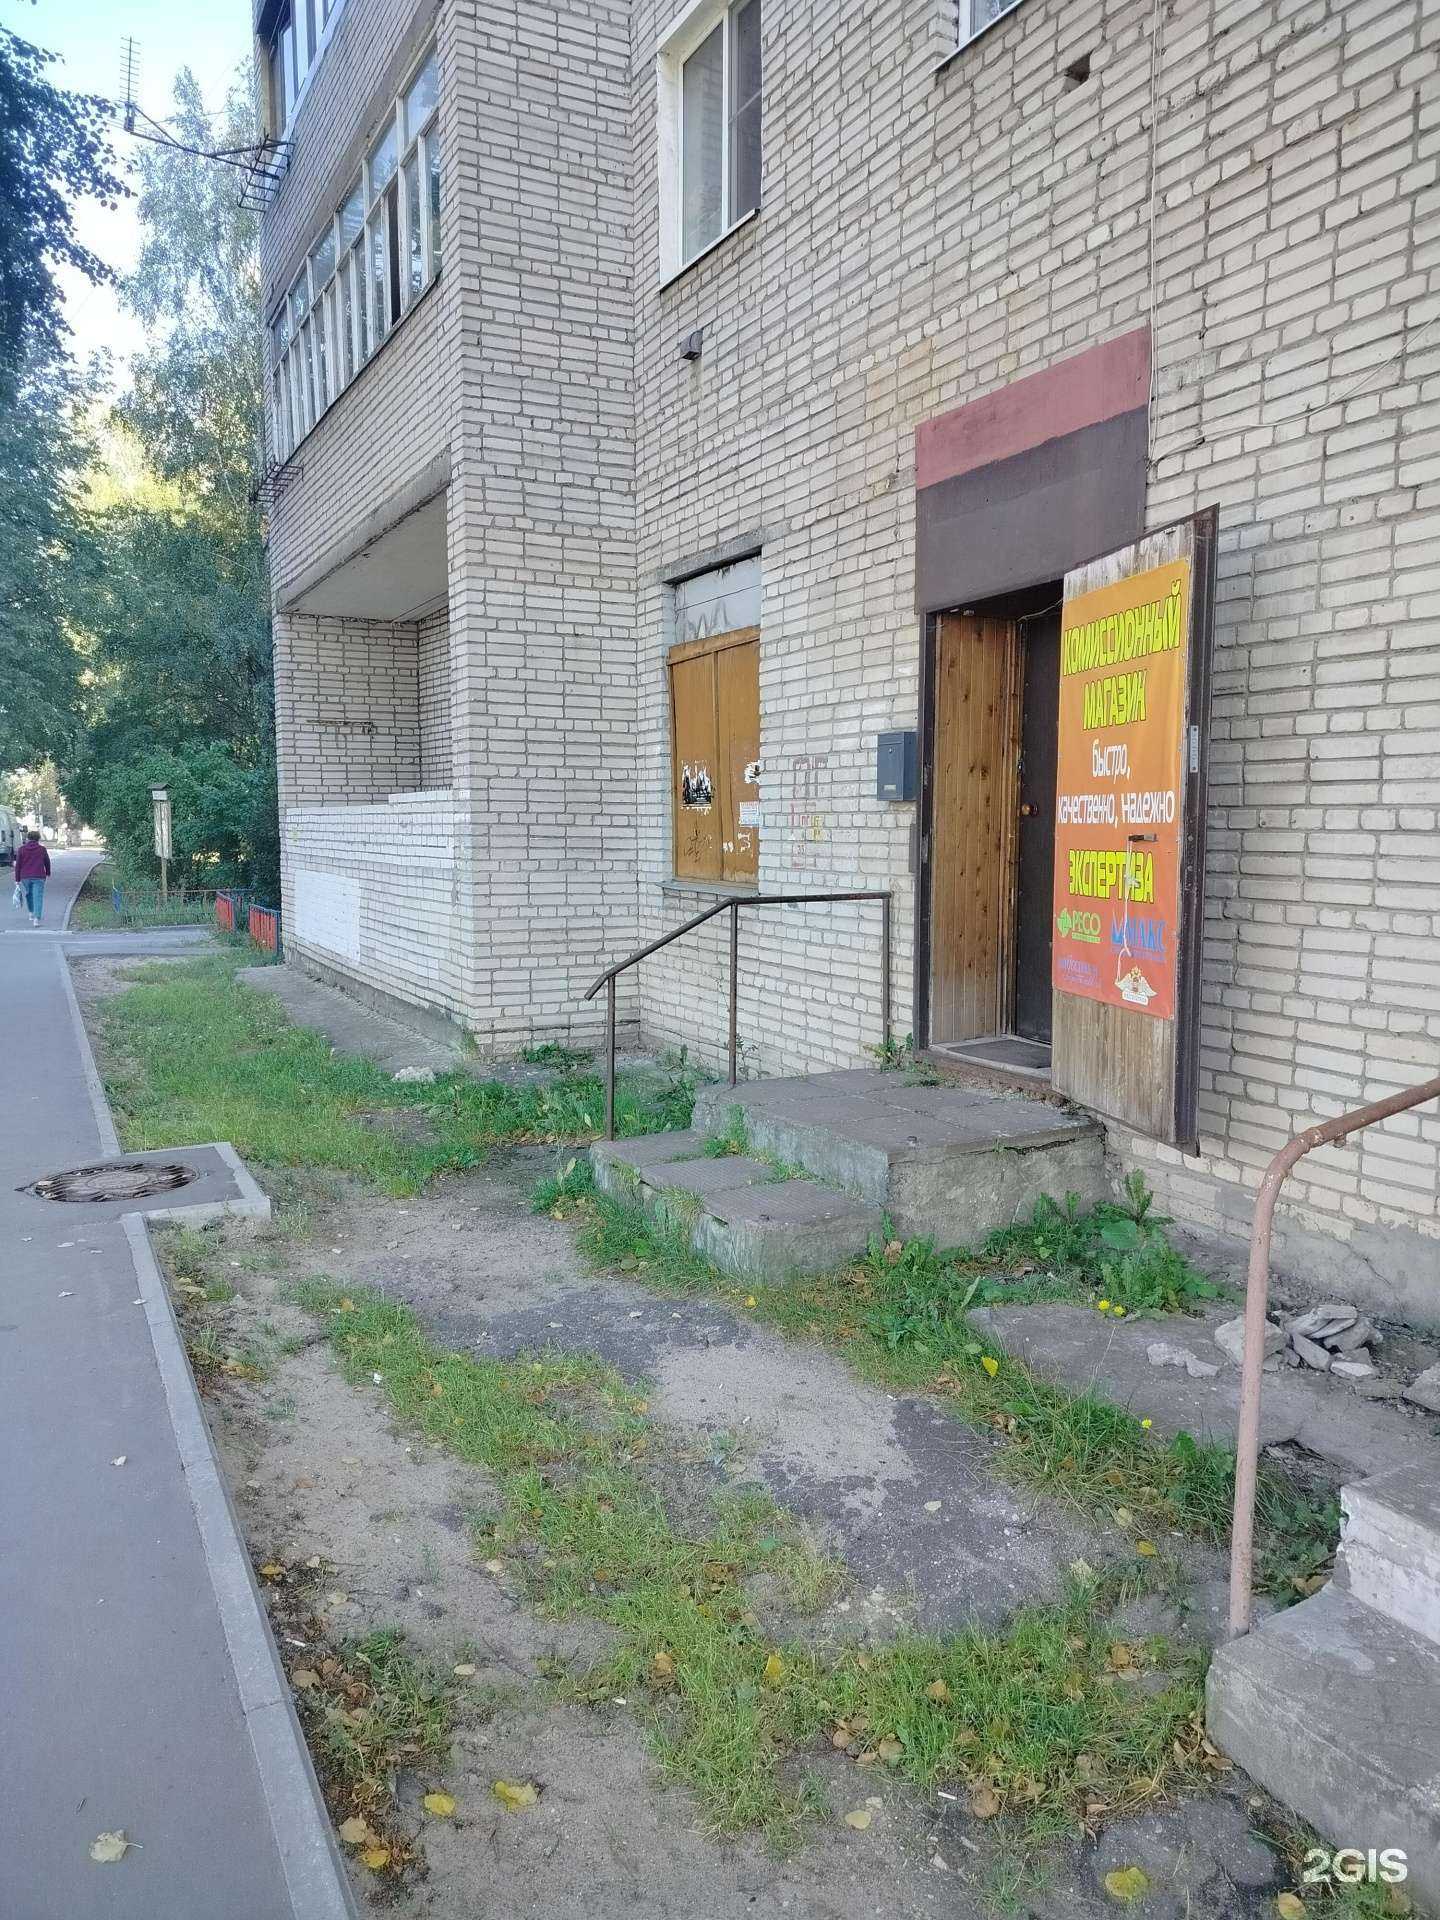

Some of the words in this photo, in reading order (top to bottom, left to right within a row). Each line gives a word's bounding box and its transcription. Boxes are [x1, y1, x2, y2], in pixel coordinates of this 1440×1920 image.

[1063, 579, 1182, 676] КОМИССИОННЫЙ
[1083, 669, 1147, 731] МАГАЗИН
[1057, 794, 1118, 828] качественно,
[1121, 790, 1175, 824] надежно
